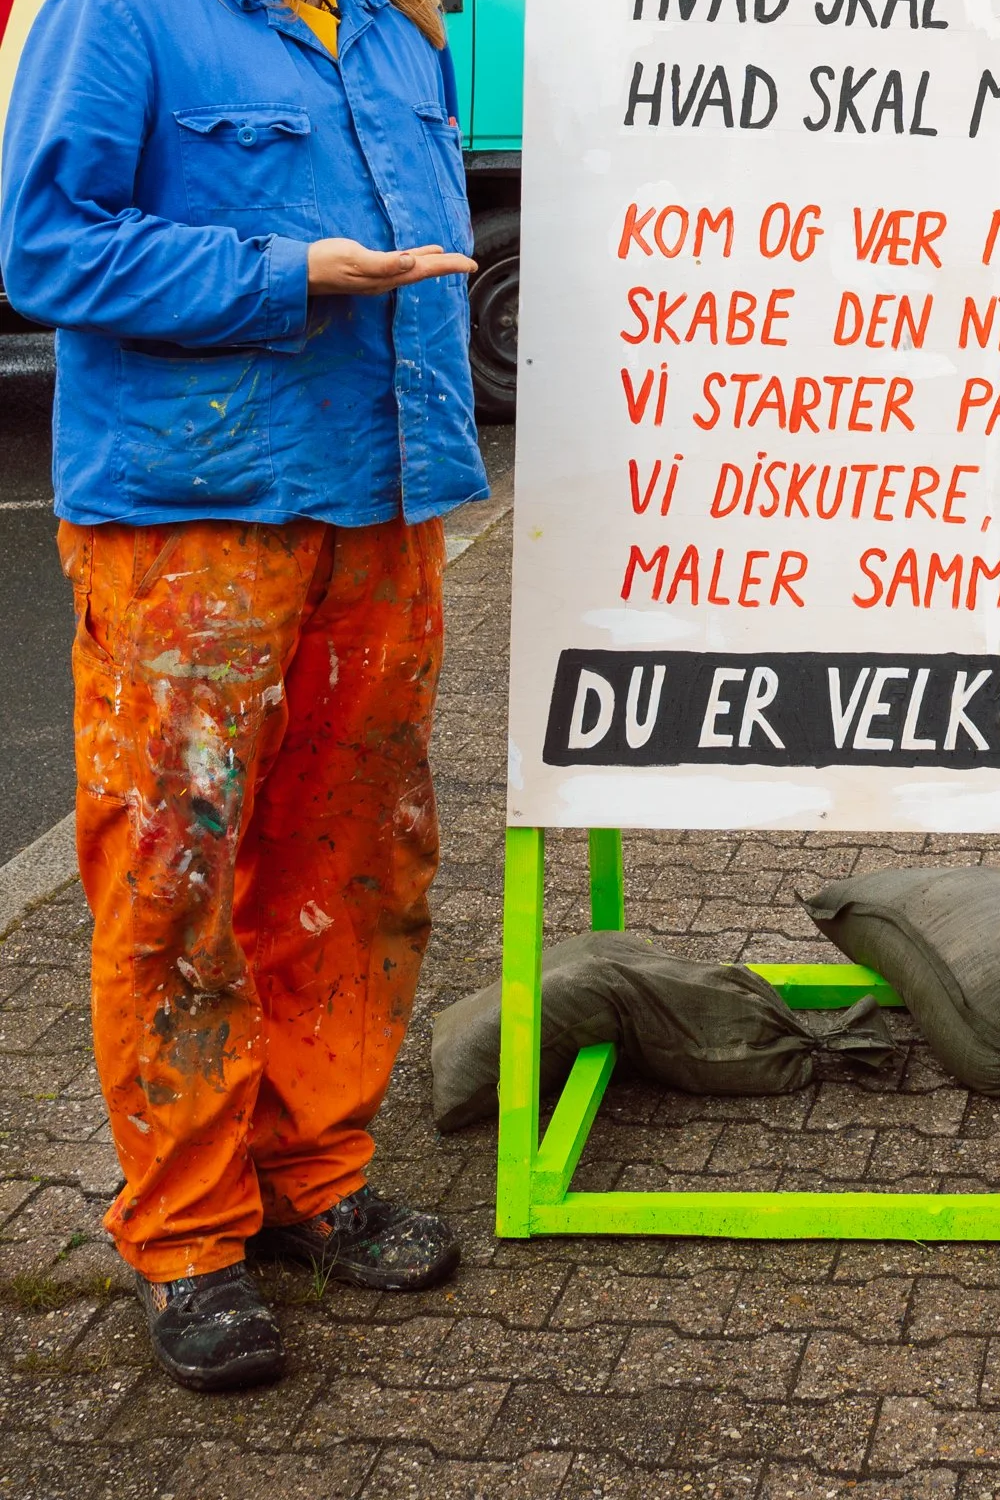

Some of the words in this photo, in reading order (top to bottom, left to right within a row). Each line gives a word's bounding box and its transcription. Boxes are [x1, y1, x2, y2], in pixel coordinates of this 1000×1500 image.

[624, 62, 777, 129] HVAD
[804, 66, 937, 136] SKAL
[618, 204, 734, 259] KOM
[760, 202, 824, 261] OG
[854, 208, 947, 268] VÆR
[621, 286, 795, 346] SKABE
[834, 292, 933, 349] DEN
[693, 372, 915, 433] STARTER
[621, 545, 808, 607] MALER
[568, 666, 666, 748] DU
[698, 667, 785, 748] ER
